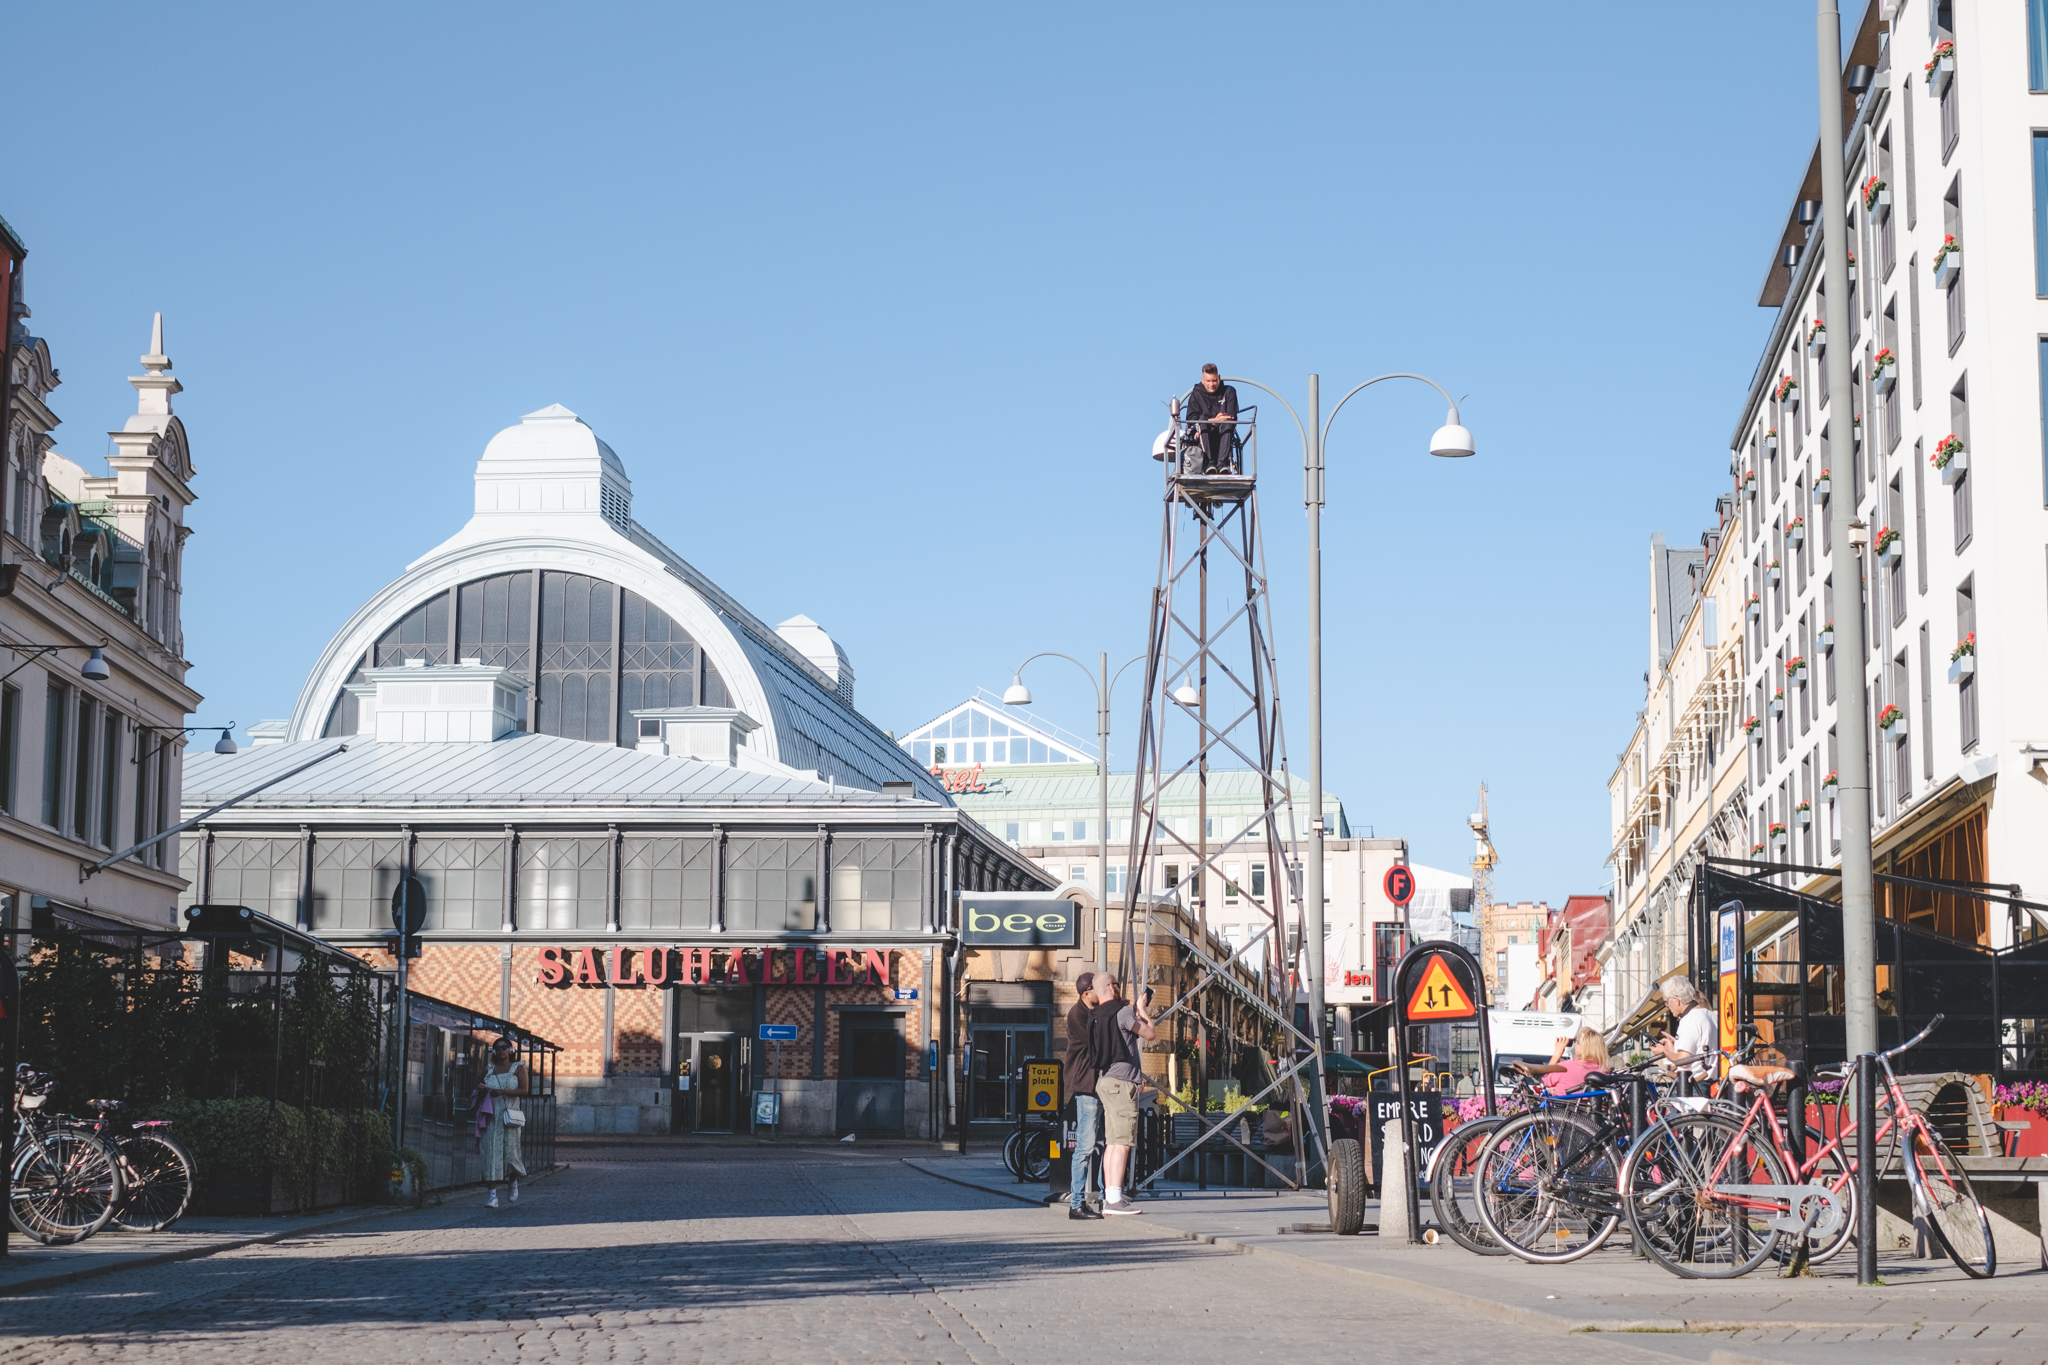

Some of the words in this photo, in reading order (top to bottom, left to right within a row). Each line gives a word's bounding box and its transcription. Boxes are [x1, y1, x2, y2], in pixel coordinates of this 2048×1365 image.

[1393, 873, 1406, 896] F
[968, 907, 1067, 933] bee
[537, 946, 895, 986] SALUHALLEN
[1032, 1067, 1056, 1075] Taxi-
[1032, 1077, 1055, 1086] plats
[1377, 1101, 1429, 1119] EMPRE
